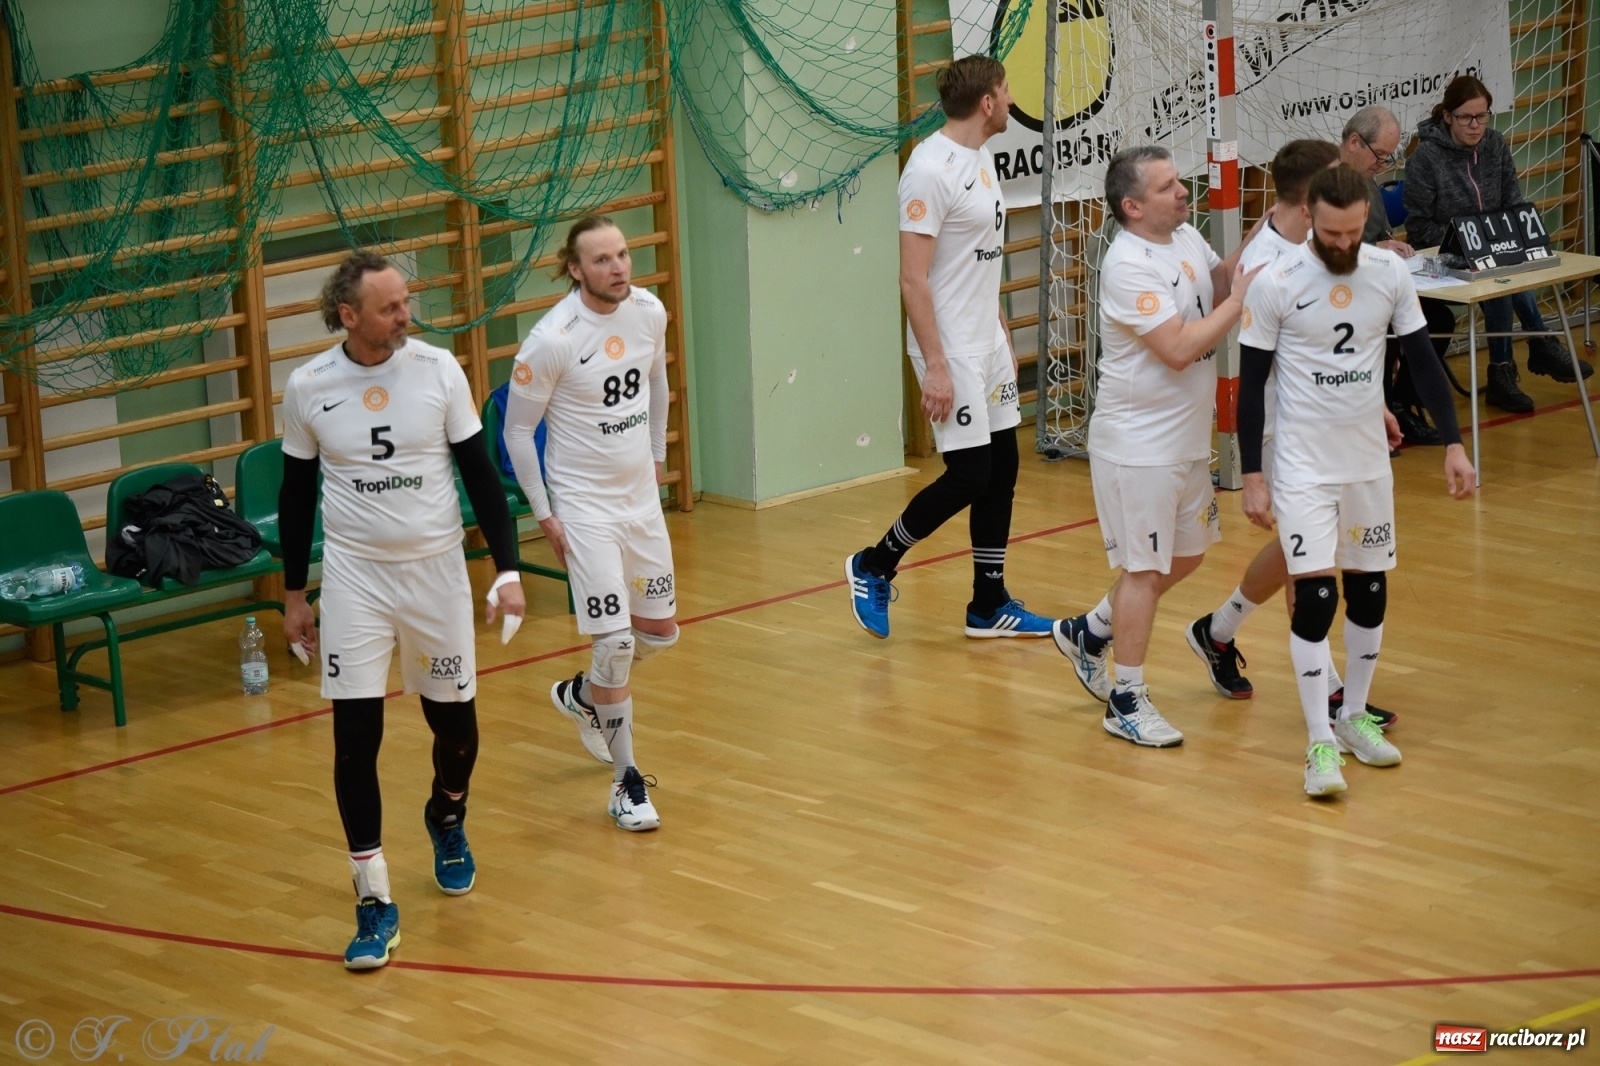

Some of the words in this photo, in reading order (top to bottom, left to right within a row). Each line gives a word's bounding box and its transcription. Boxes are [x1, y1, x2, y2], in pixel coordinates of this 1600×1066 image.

[993, 128, 1122, 182] RACBÓR
[995, 200, 1003, 232] 6
[1458, 221, 1482, 251] 18
[1485, 216, 1496, 236] 1
[1502, 212, 1513, 233] 1
[1519, 207, 1546, 240] 21
[1333, 322, 1355, 355] 2
[603, 368, 641, 407] 88
[1312, 370, 1372, 387] TropiDog
[598, 411, 648, 435] TropiDog
[956, 405, 972, 426] 6
[371, 425, 395, 461] 5
[352, 475, 423, 494] TropiDog
[1361, 532, 1391, 545] MAR
[1363, 522, 1391, 537] ZOO
[1148, 531, 1159, 552] 1
[1290, 534, 1306, 557] 2
[645, 583, 673, 596] MAR
[646, 573, 673, 588] ZOO
[587, 594, 620, 618] 88
[327, 654, 340, 678] 5
[431, 655, 462, 668] ZOO
[431, 665, 462, 676] MAR
